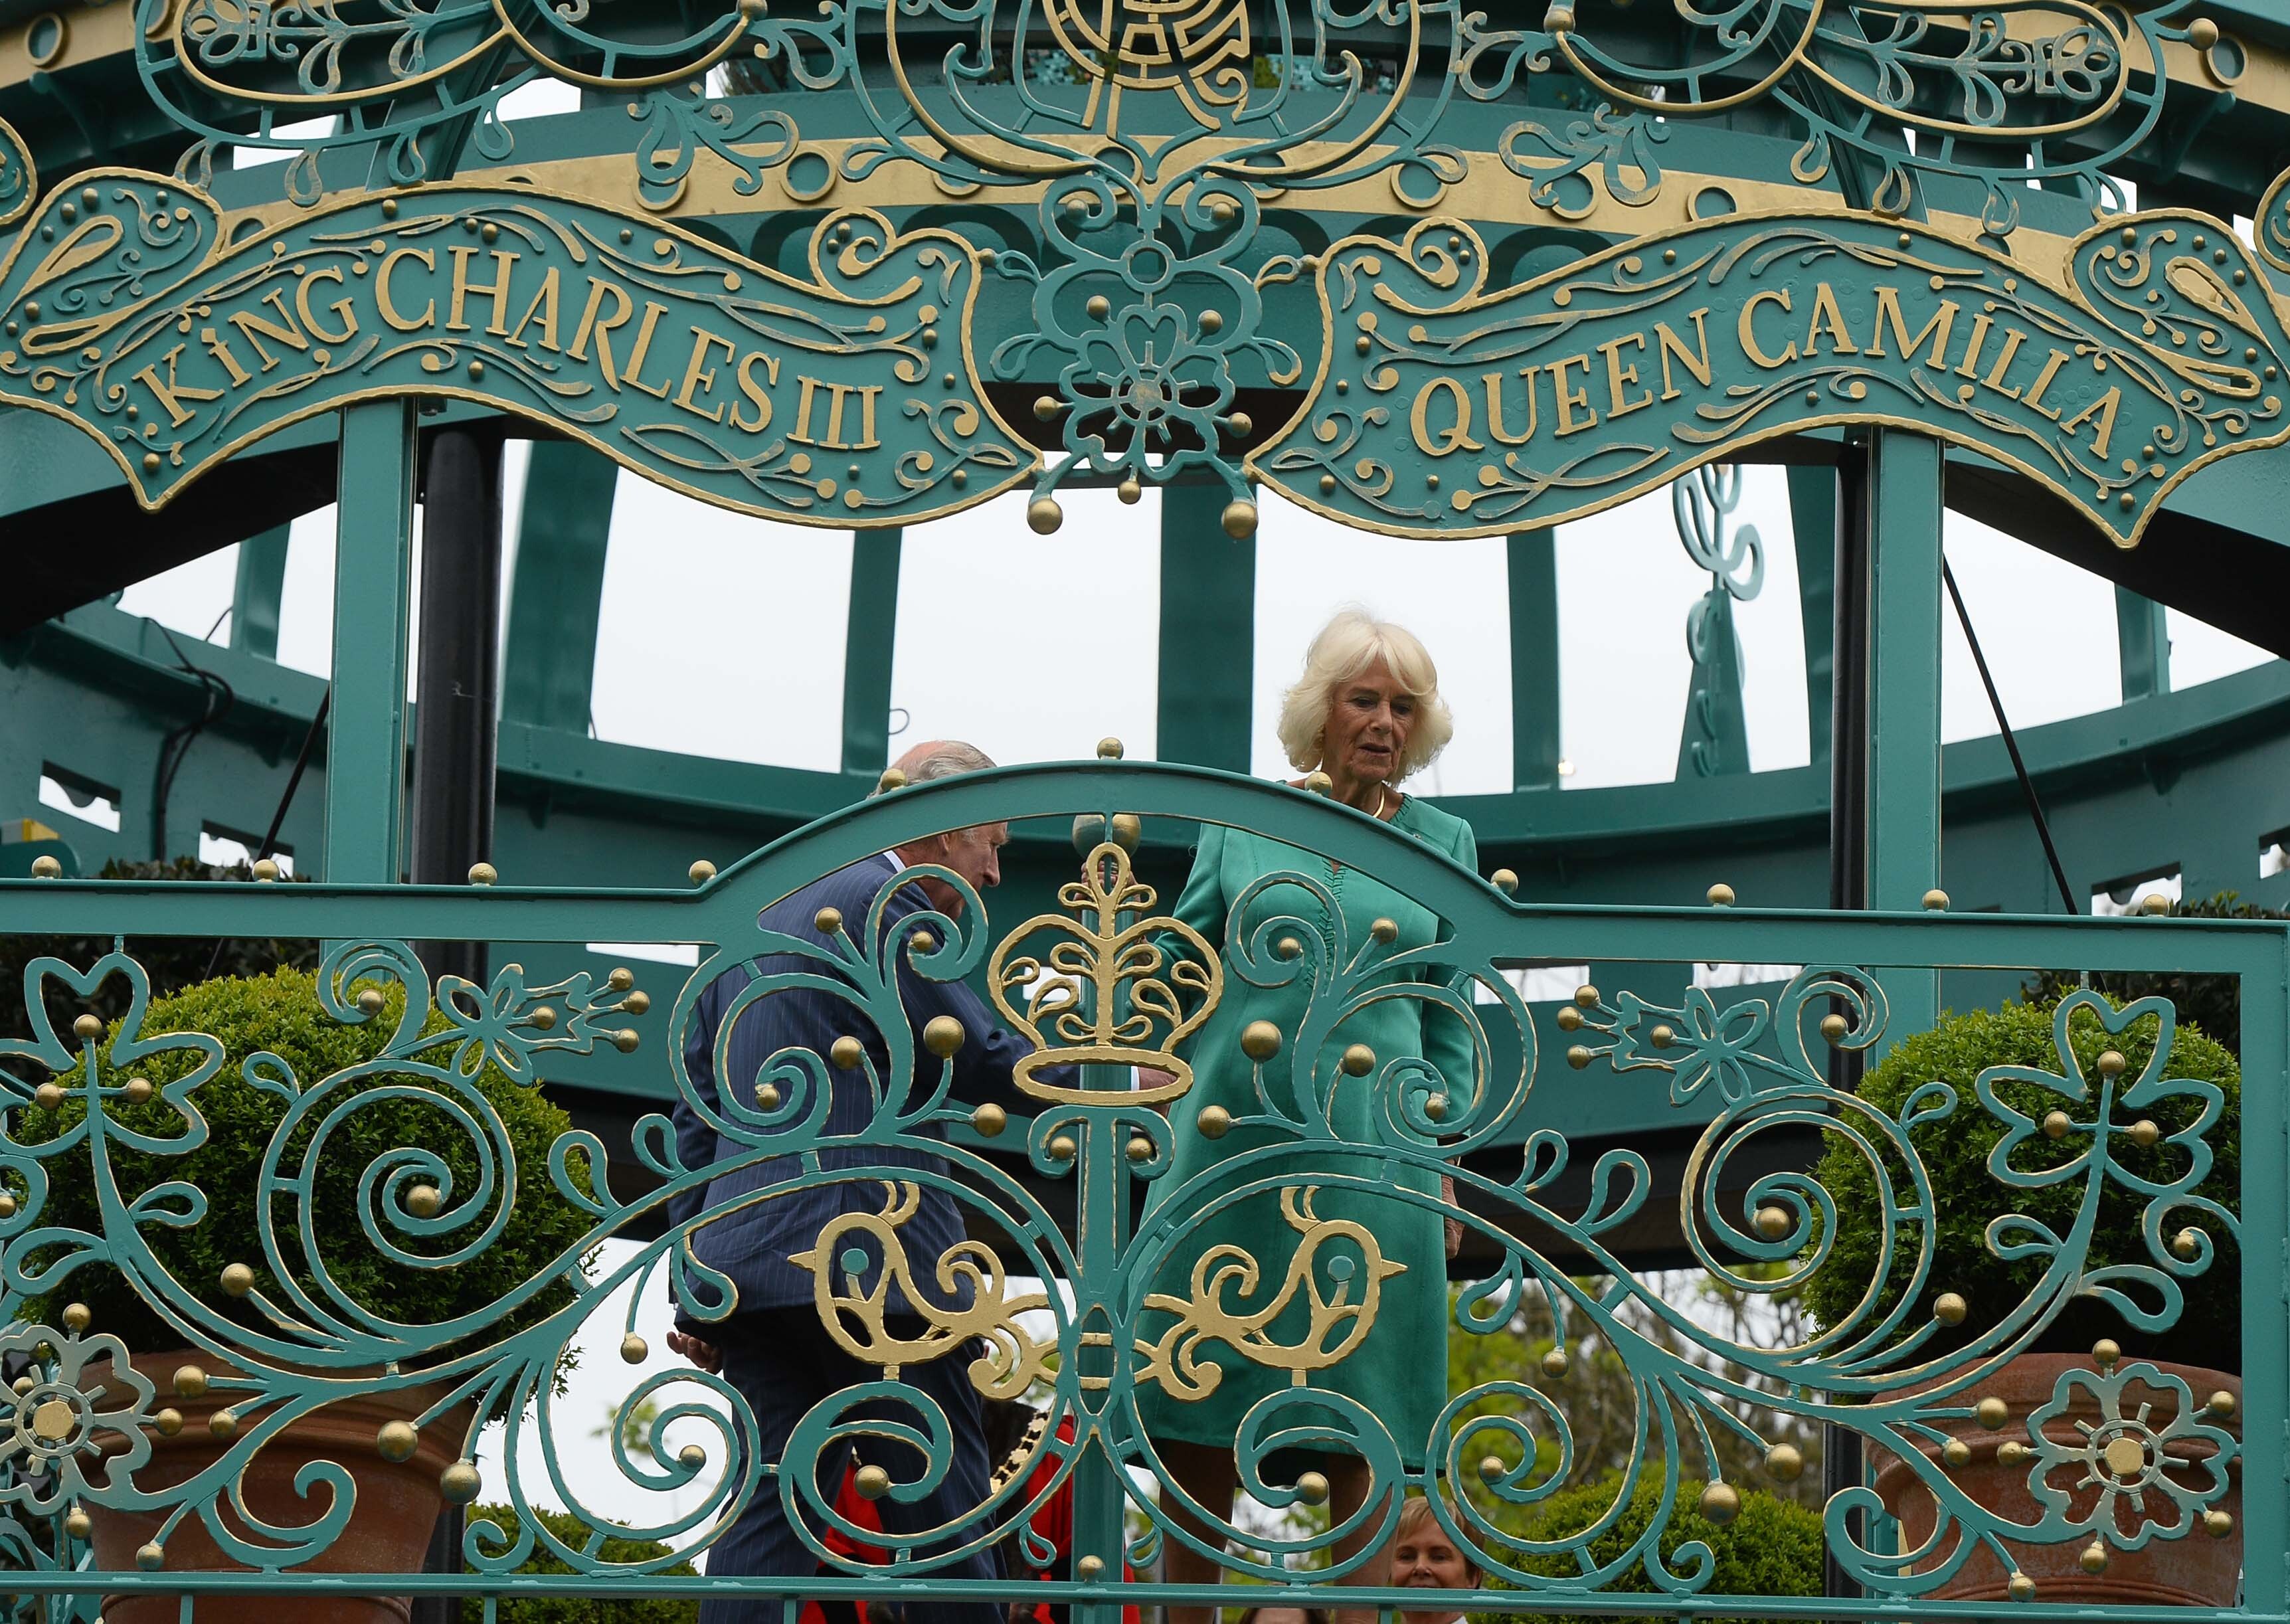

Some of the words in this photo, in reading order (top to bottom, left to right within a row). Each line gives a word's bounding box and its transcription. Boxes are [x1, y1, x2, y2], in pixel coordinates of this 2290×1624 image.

[132, 264, 359, 430] KING
[375, 246, 780, 433] CHARLES
[786, 375, 883, 449] III
[1410, 308, 1712, 457] QUEEN
[1737, 282, 2122, 460] CAMILLA
